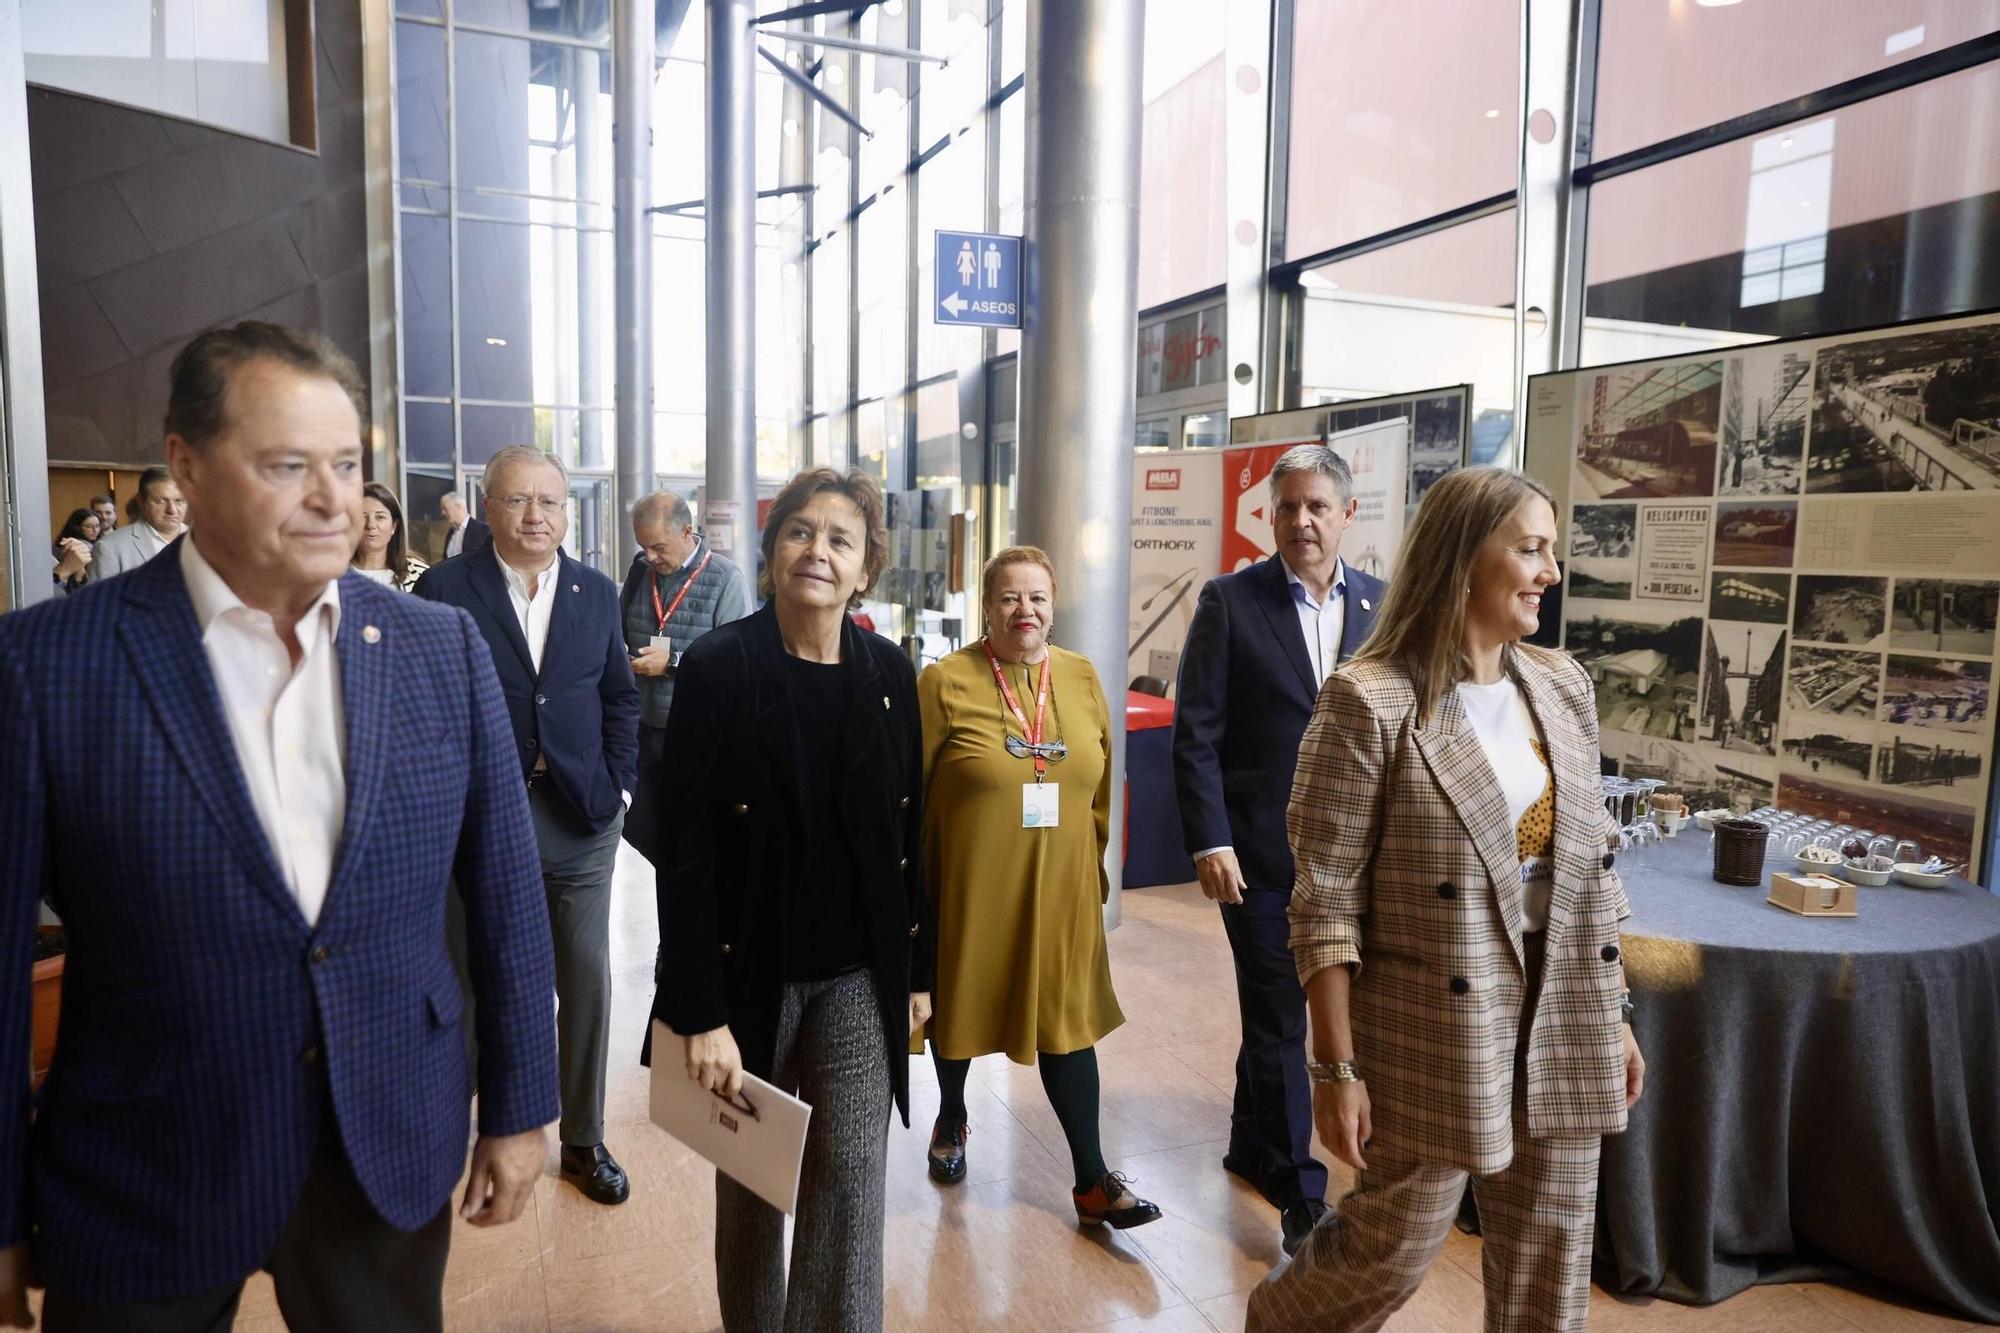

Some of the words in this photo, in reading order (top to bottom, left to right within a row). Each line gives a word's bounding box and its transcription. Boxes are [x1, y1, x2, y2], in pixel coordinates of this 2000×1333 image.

[971, 300, 1016, 315] ASEOS
[1148, 471, 1177, 484] MBA
[1647, 510, 1707, 521] HELICOPTERO
[1134, 539, 1196, 551] ORTHOFIX
[1663, 583, 1692, 595] PESETAS
